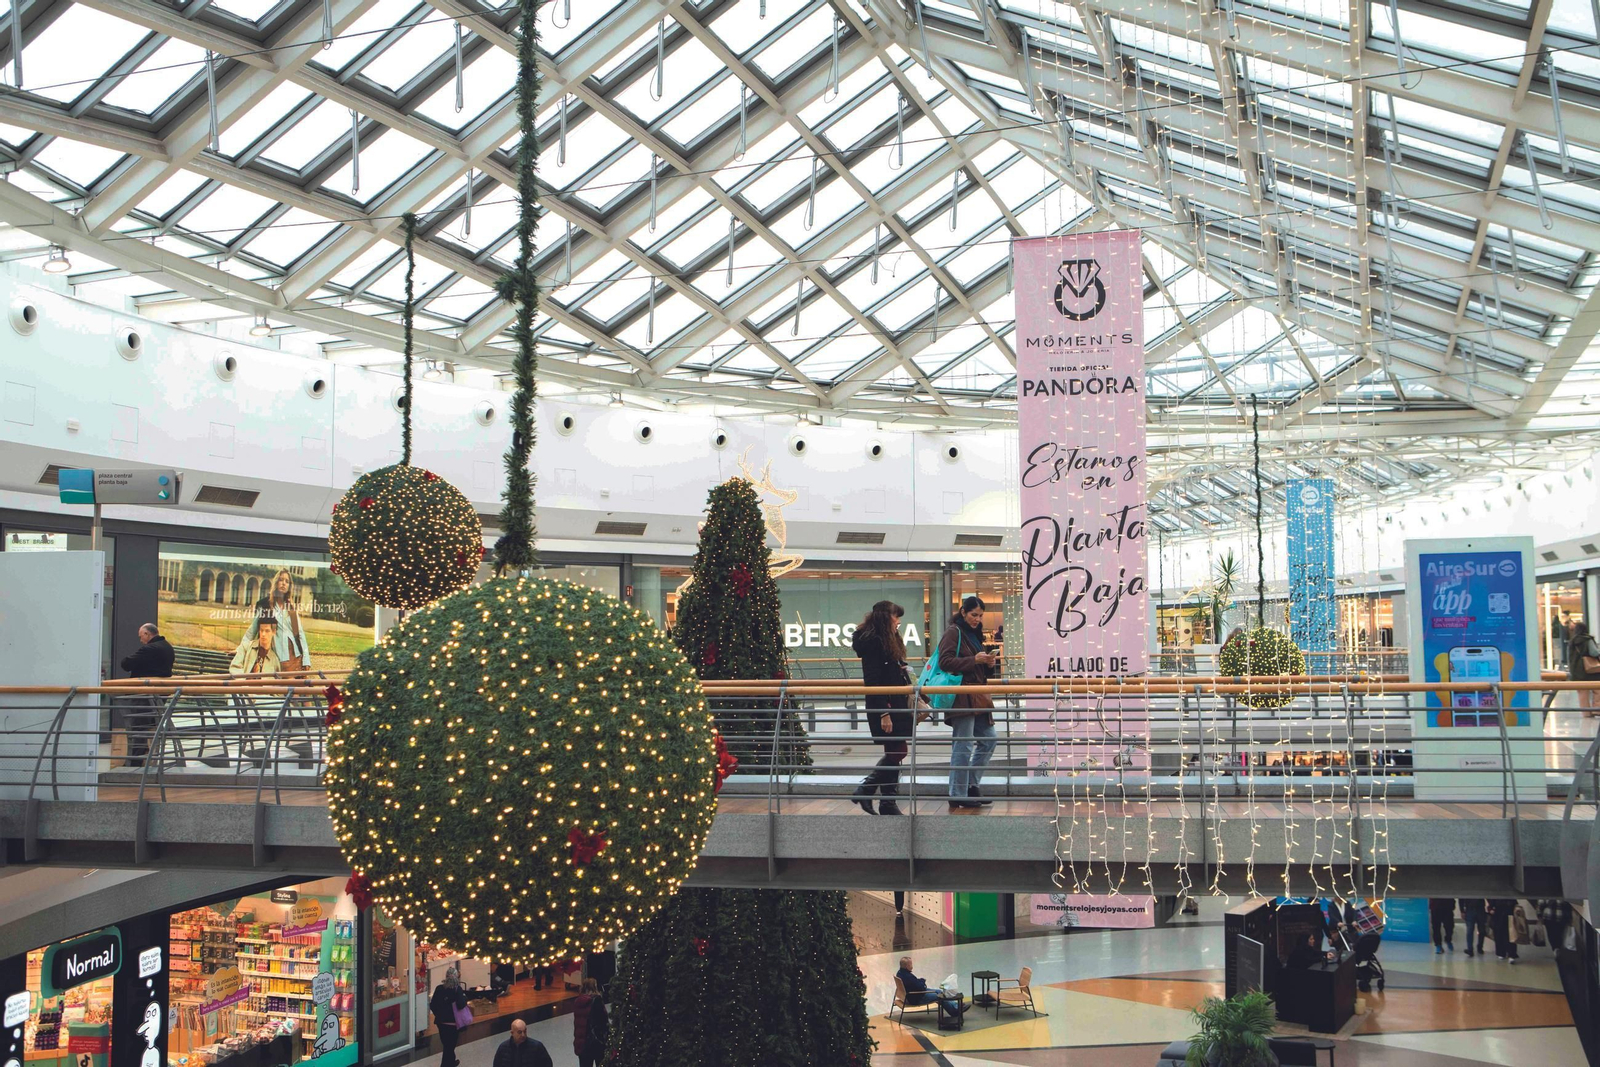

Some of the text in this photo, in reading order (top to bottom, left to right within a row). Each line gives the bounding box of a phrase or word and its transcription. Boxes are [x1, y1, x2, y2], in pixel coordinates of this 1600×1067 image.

[1022, 375, 1138, 397] PANDORA
[1021, 442, 1143, 488] Estamos
[1081, 474, 1116, 490] en
[1021, 505, 1148, 589] Planta
[1426, 560, 1497, 577] AireSur
[1027, 566, 1148, 638] Baja
[1433, 589, 1473, 615] app
[784, 623, 922, 648] BERSA
[1048, 657, 1128, 672] AL LADO DE
[1036, 904, 1146, 914] momentsrelojesyjoyas.com
[67, 943, 114, 980] Normal
